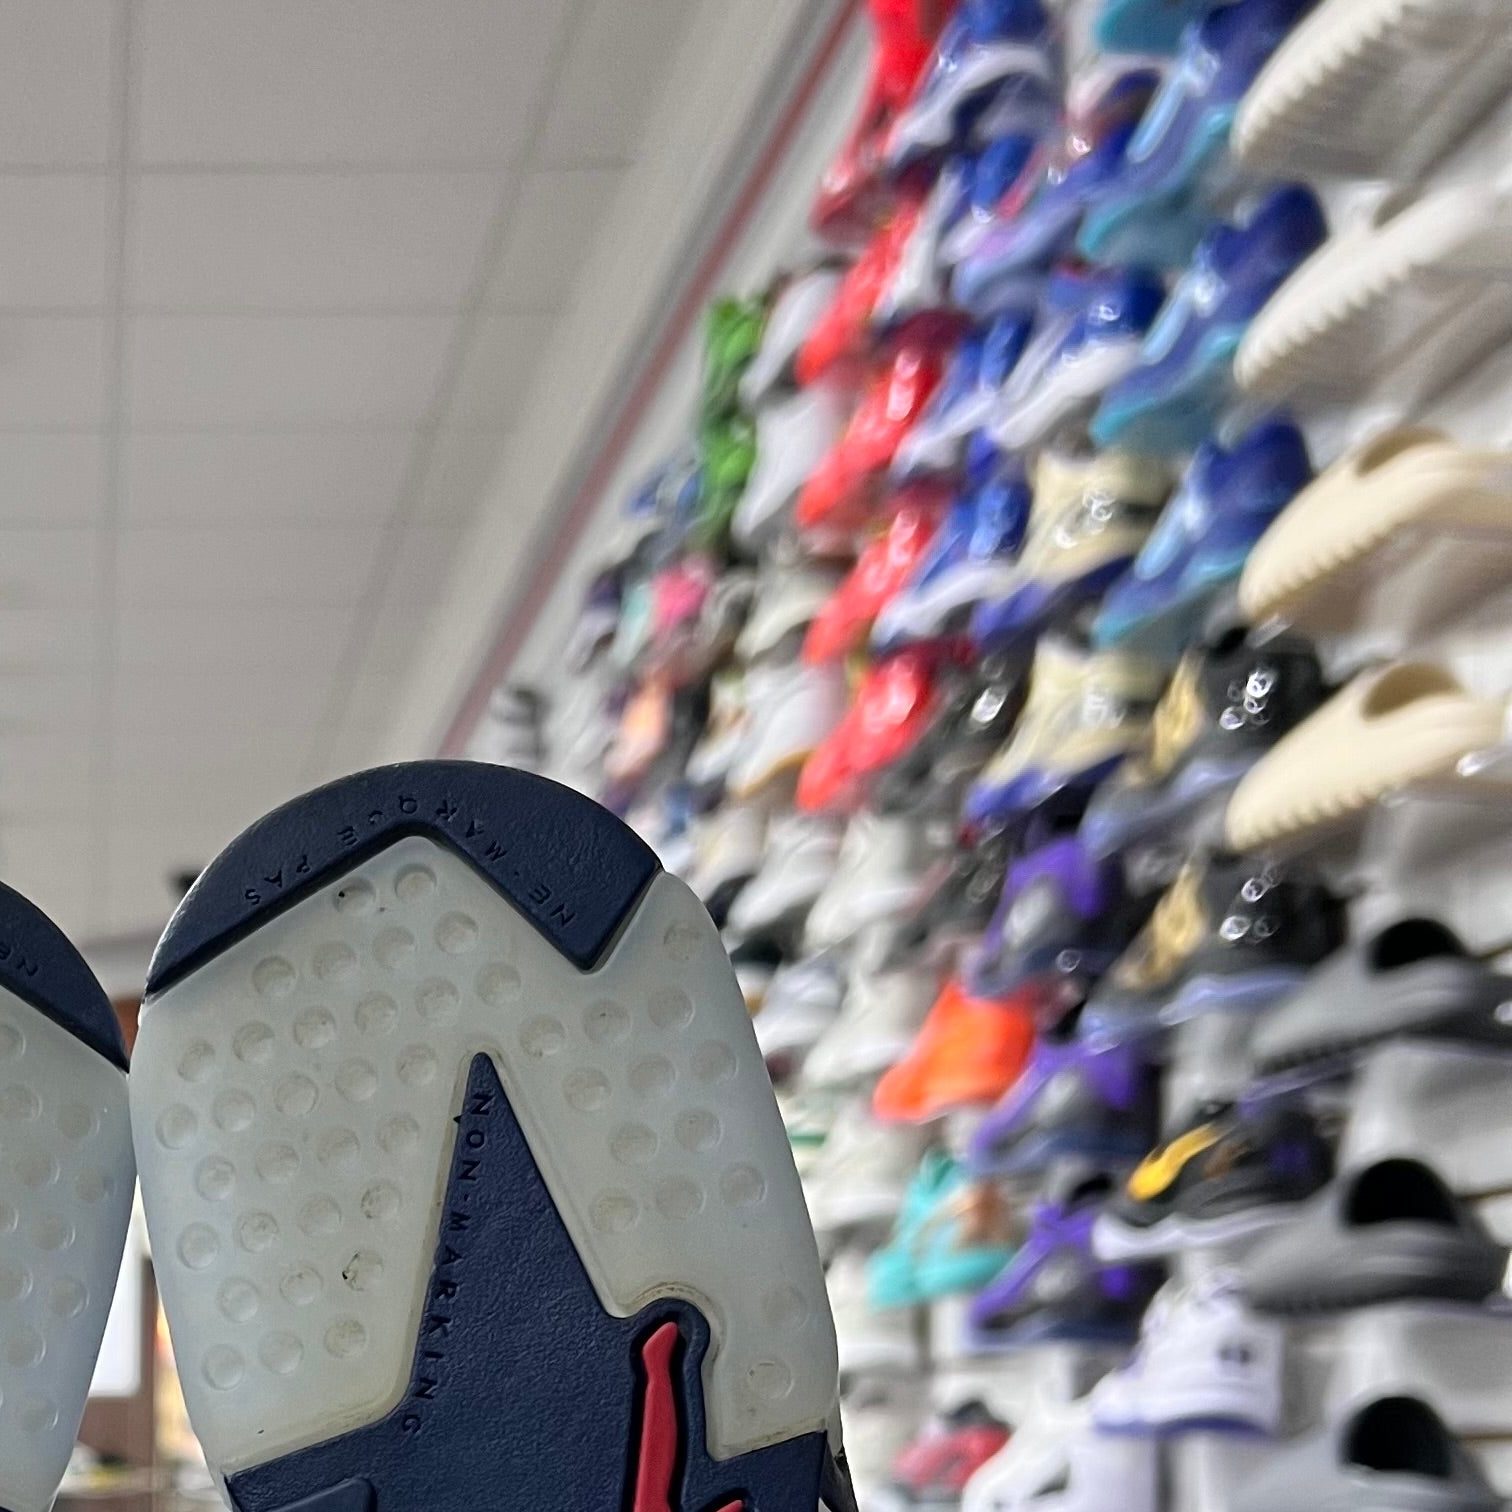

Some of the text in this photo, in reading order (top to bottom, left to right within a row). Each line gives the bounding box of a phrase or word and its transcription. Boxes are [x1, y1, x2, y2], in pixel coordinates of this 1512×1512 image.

[244, 793, 577, 928] NE MARQUE PAS
[401, 1092, 492, 1435] NON-MARKING
